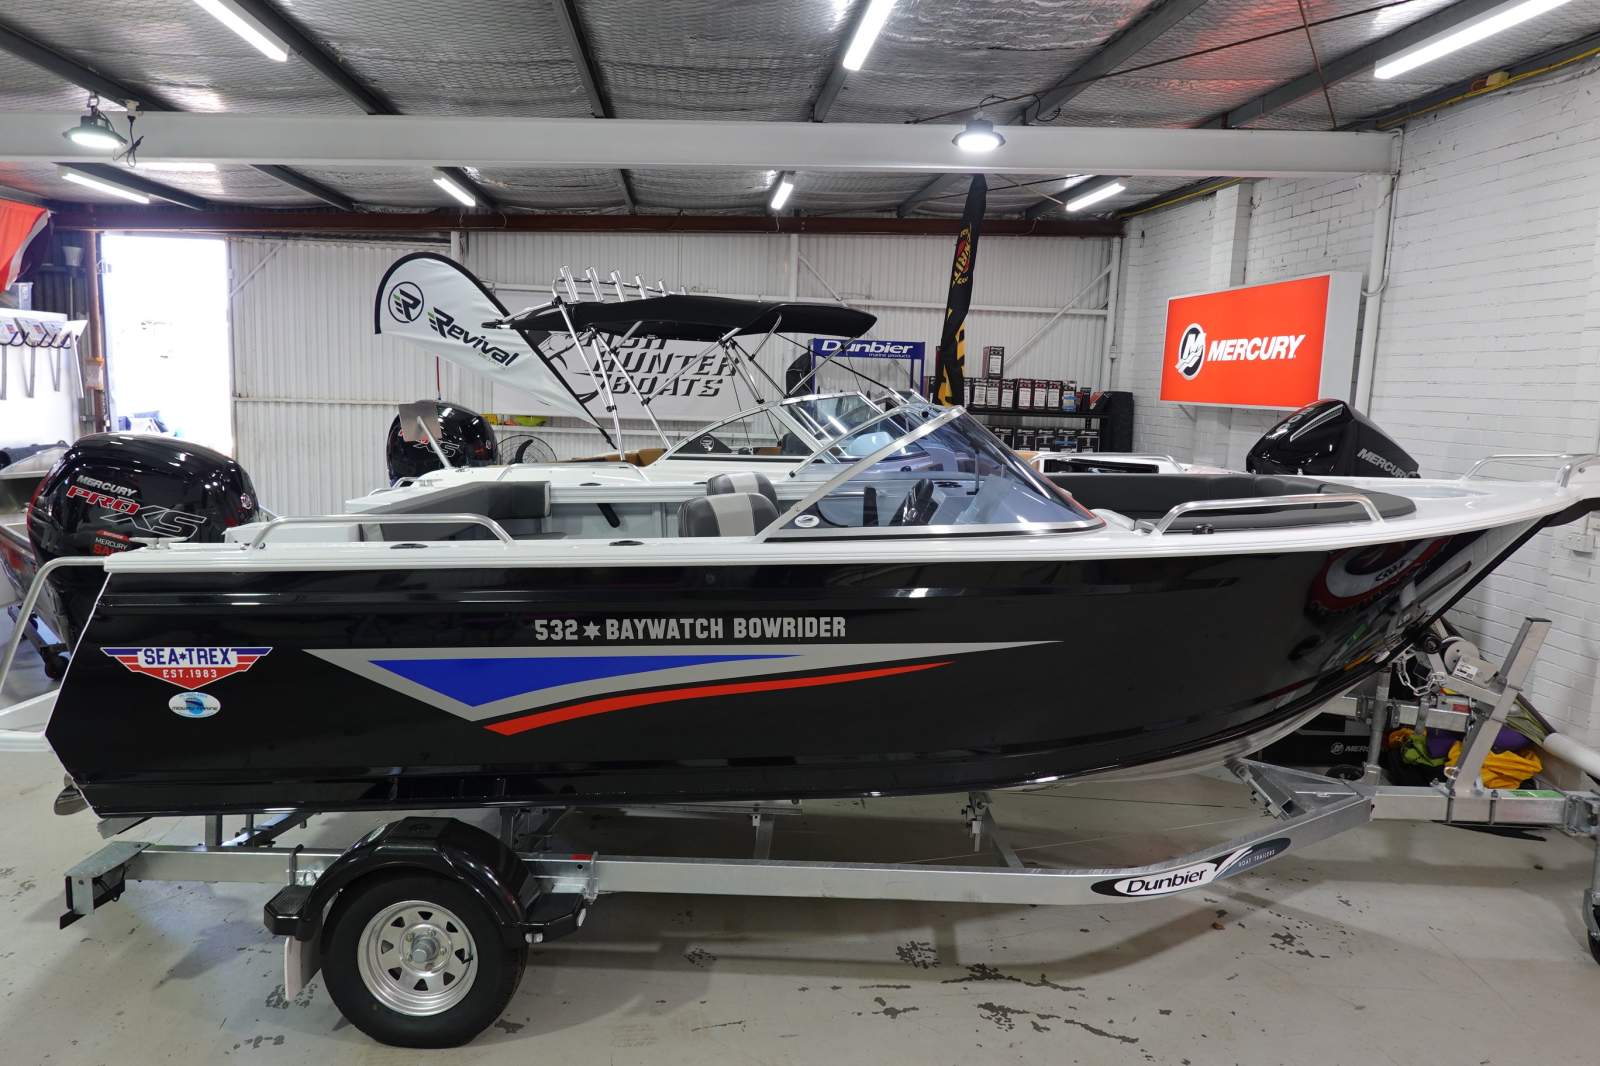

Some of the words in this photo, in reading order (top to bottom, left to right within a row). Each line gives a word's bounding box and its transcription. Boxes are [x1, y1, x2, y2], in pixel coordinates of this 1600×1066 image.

[427, 306, 519, 366] Revival
[1207, 334, 1306, 361] MERCURY
[593, 351, 740, 376] HUNTER
[611, 376, 724, 397] BOATS
[76, 475, 137, 497] MERCURY
[66, 485, 140, 515] PRO
[100, 505, 207, 541] XS
[95, 537, 129, 550] MERCURY
[534, 619, 578, 640] 532
[606, 618, 724, 640] BAYWATCH
[733, 616, 847, 639] BOWRIDER
[1126, 868, 1207, 893] Dunbier
